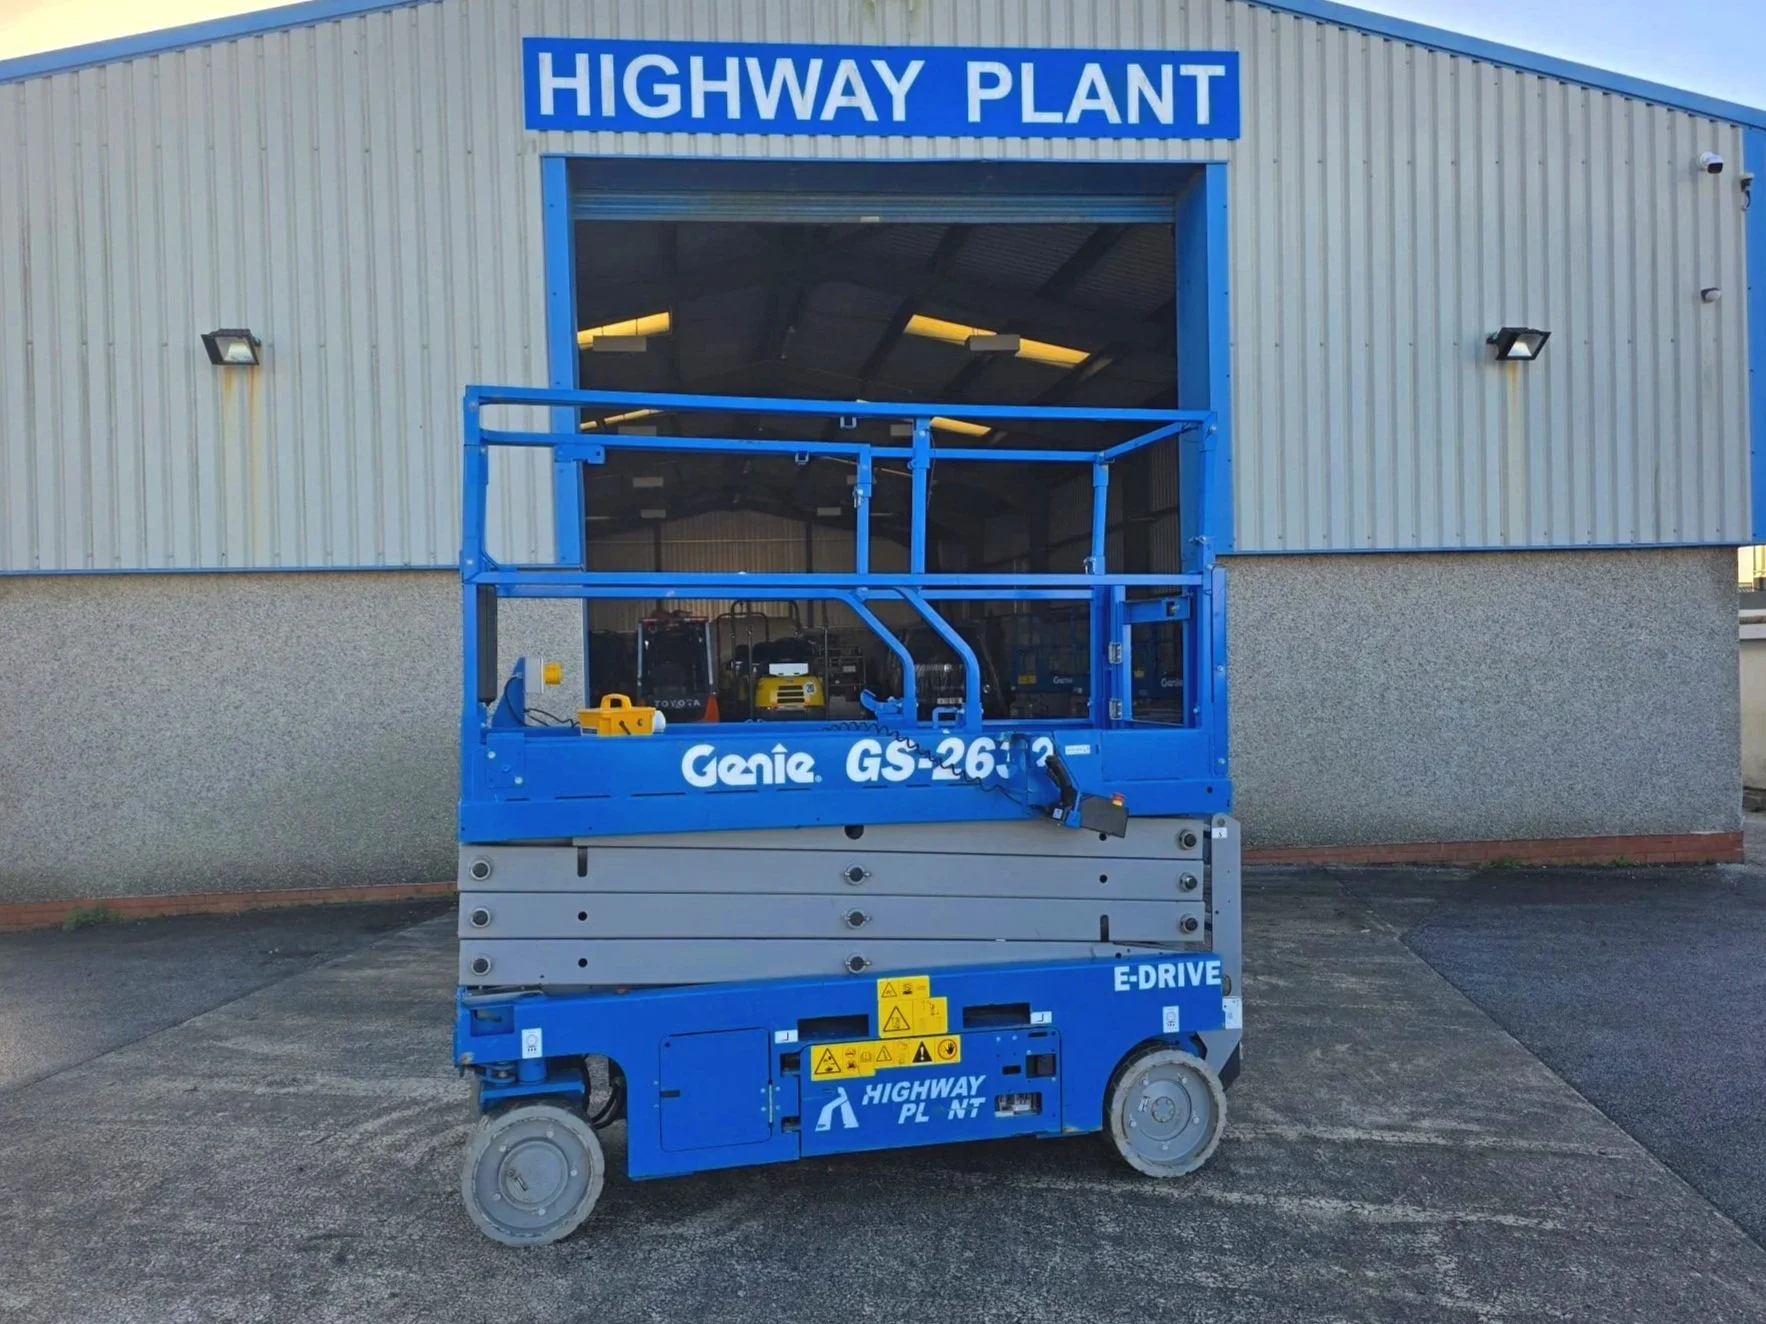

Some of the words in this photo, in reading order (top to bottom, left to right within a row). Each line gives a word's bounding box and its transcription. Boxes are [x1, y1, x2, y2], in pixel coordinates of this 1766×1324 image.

[537, 51, 925, 122] HIGHWAY
[966, 60, 1226, 126] PLANT
[654, 699, 700, 708] TOYOTA
[681, 743, 815, 787] Genie
[1114, 960, 1222, 991] E-DRIVE
[861, 1075, 986, 1105] HIGHWAY
[898, 1097, 986, 1124] PLNT
